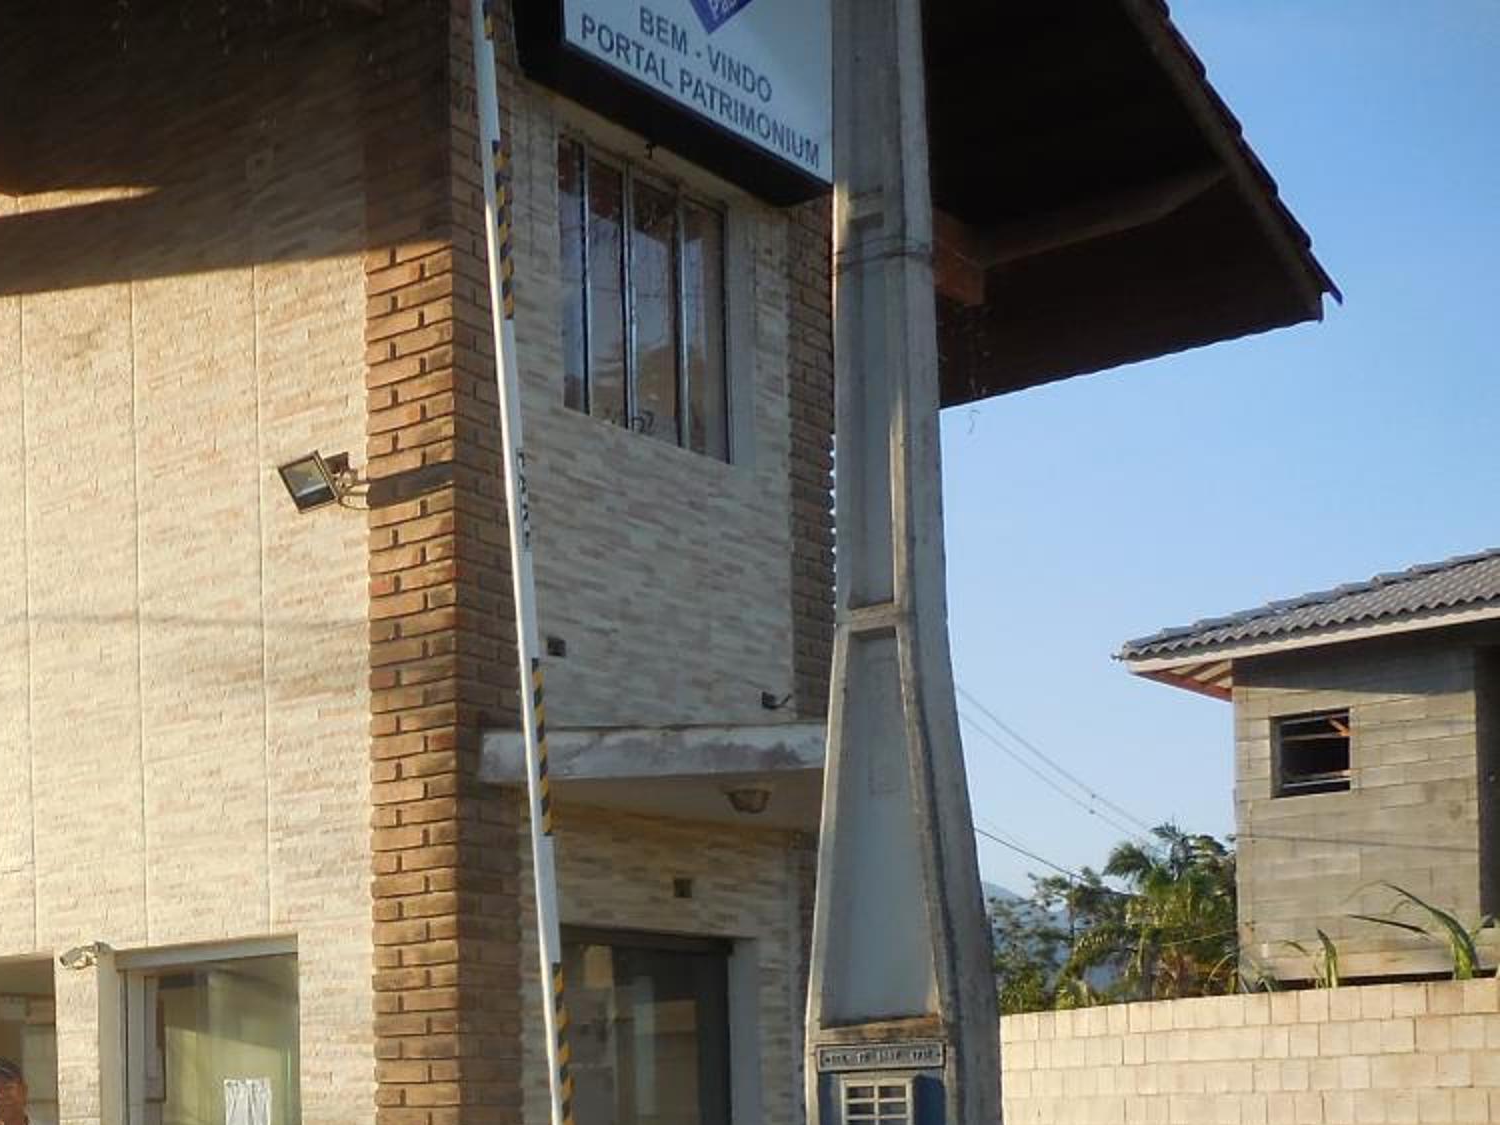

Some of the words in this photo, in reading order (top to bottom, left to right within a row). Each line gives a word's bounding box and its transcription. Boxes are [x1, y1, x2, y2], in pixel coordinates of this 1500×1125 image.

[581, 14, 673, 88] PORTAL
[680, 68, 819, 169] PATRIMONIUM
[640, 7, 687, 55] BEM
[708, 44, 772, 103] VINDO
